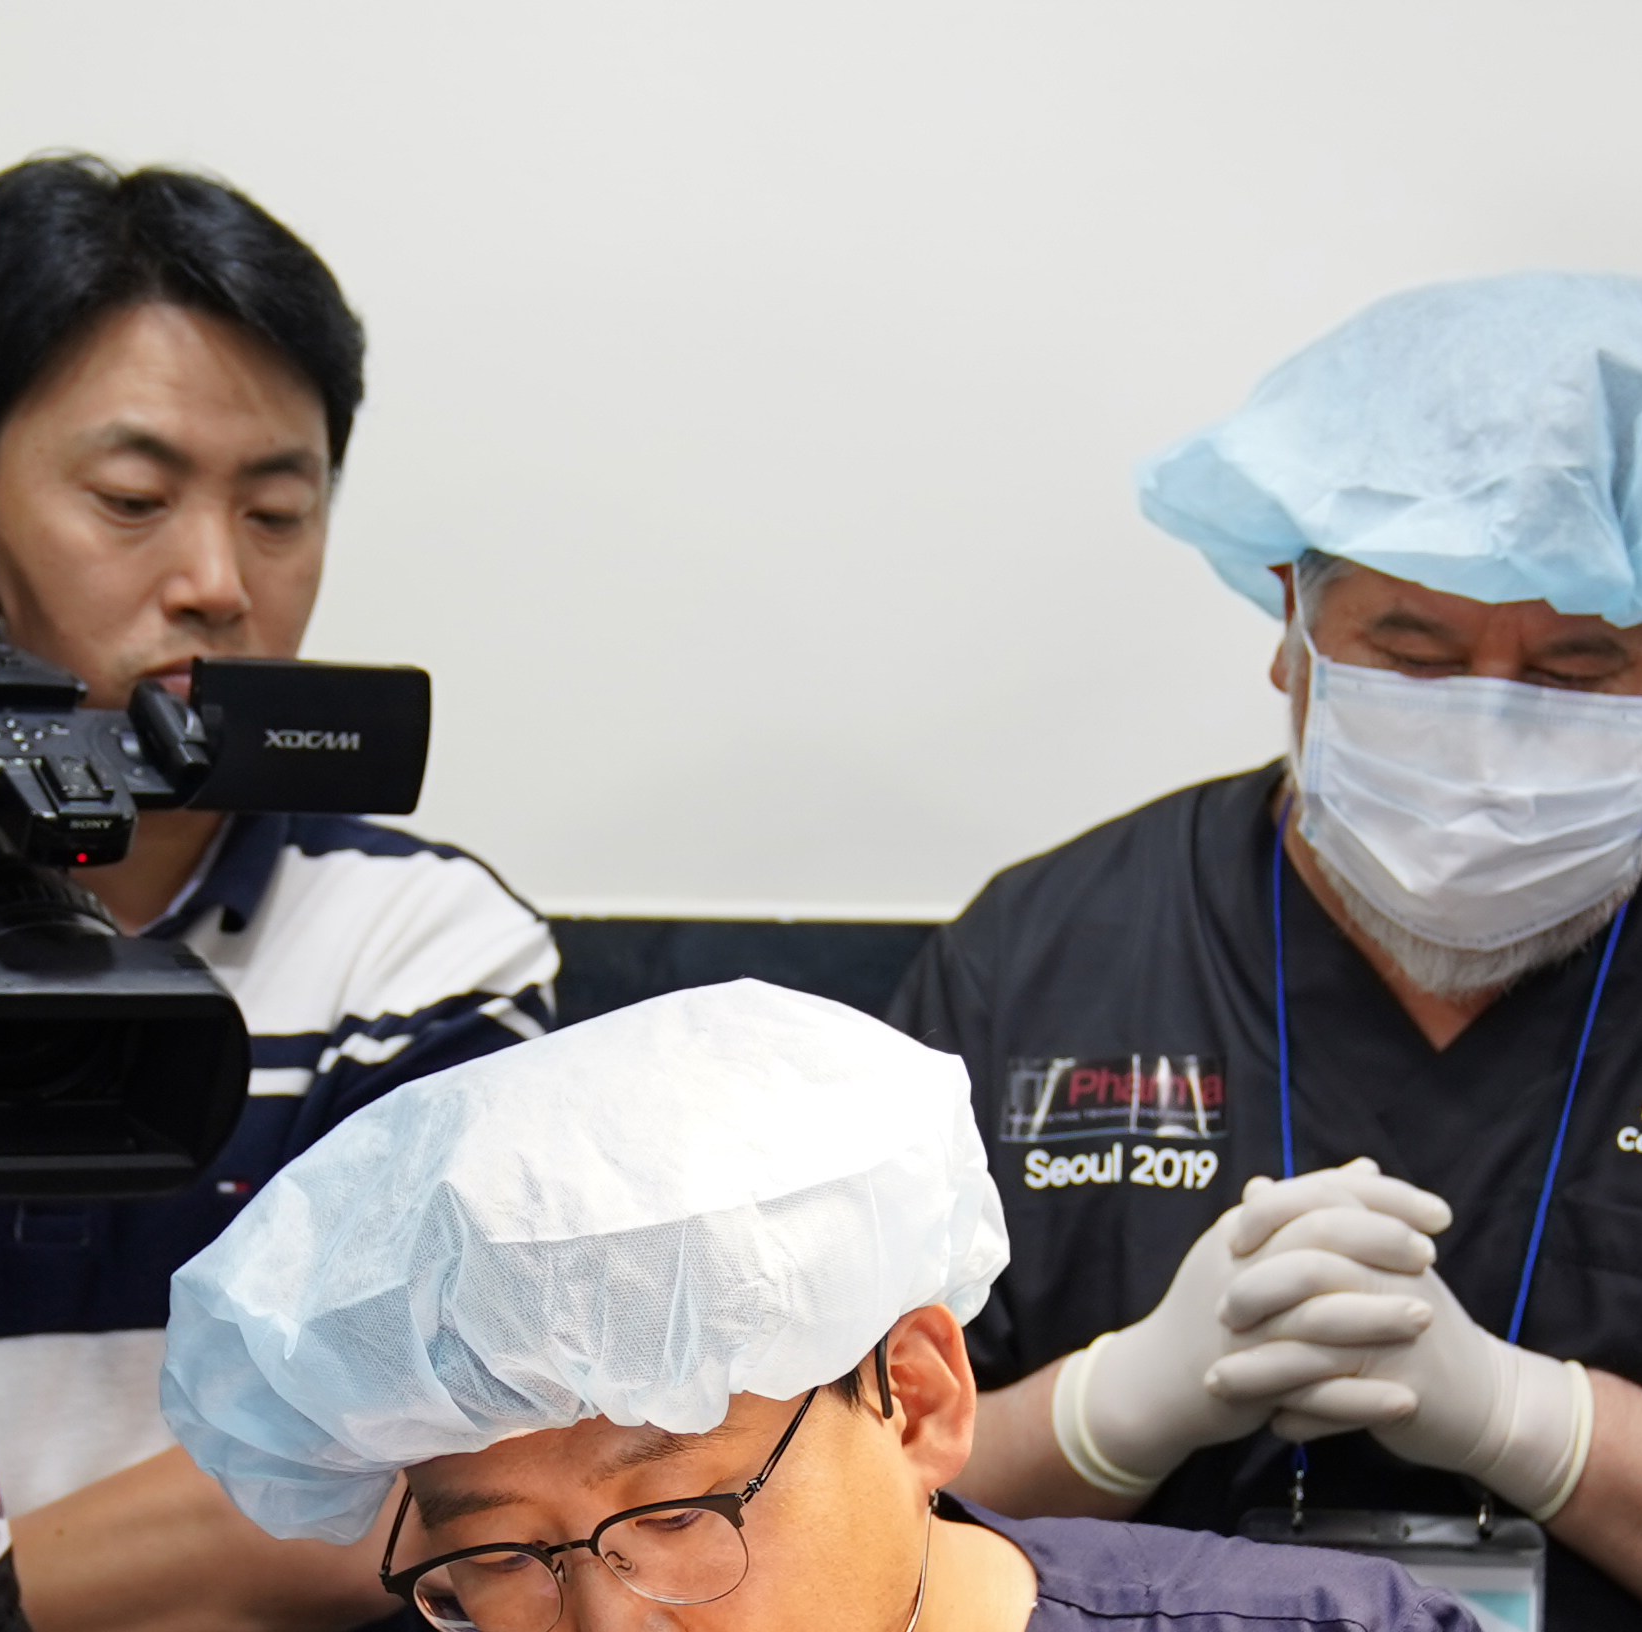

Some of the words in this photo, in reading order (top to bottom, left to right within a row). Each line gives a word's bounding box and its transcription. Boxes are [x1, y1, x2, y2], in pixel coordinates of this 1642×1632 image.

[264, 730, 360, 752] XDCAM
[69, 818, 113, 831] SONY
[1024, 1142, 1124, 1190] Seoul
[1129, 1145, 1219, 1190] 2019
